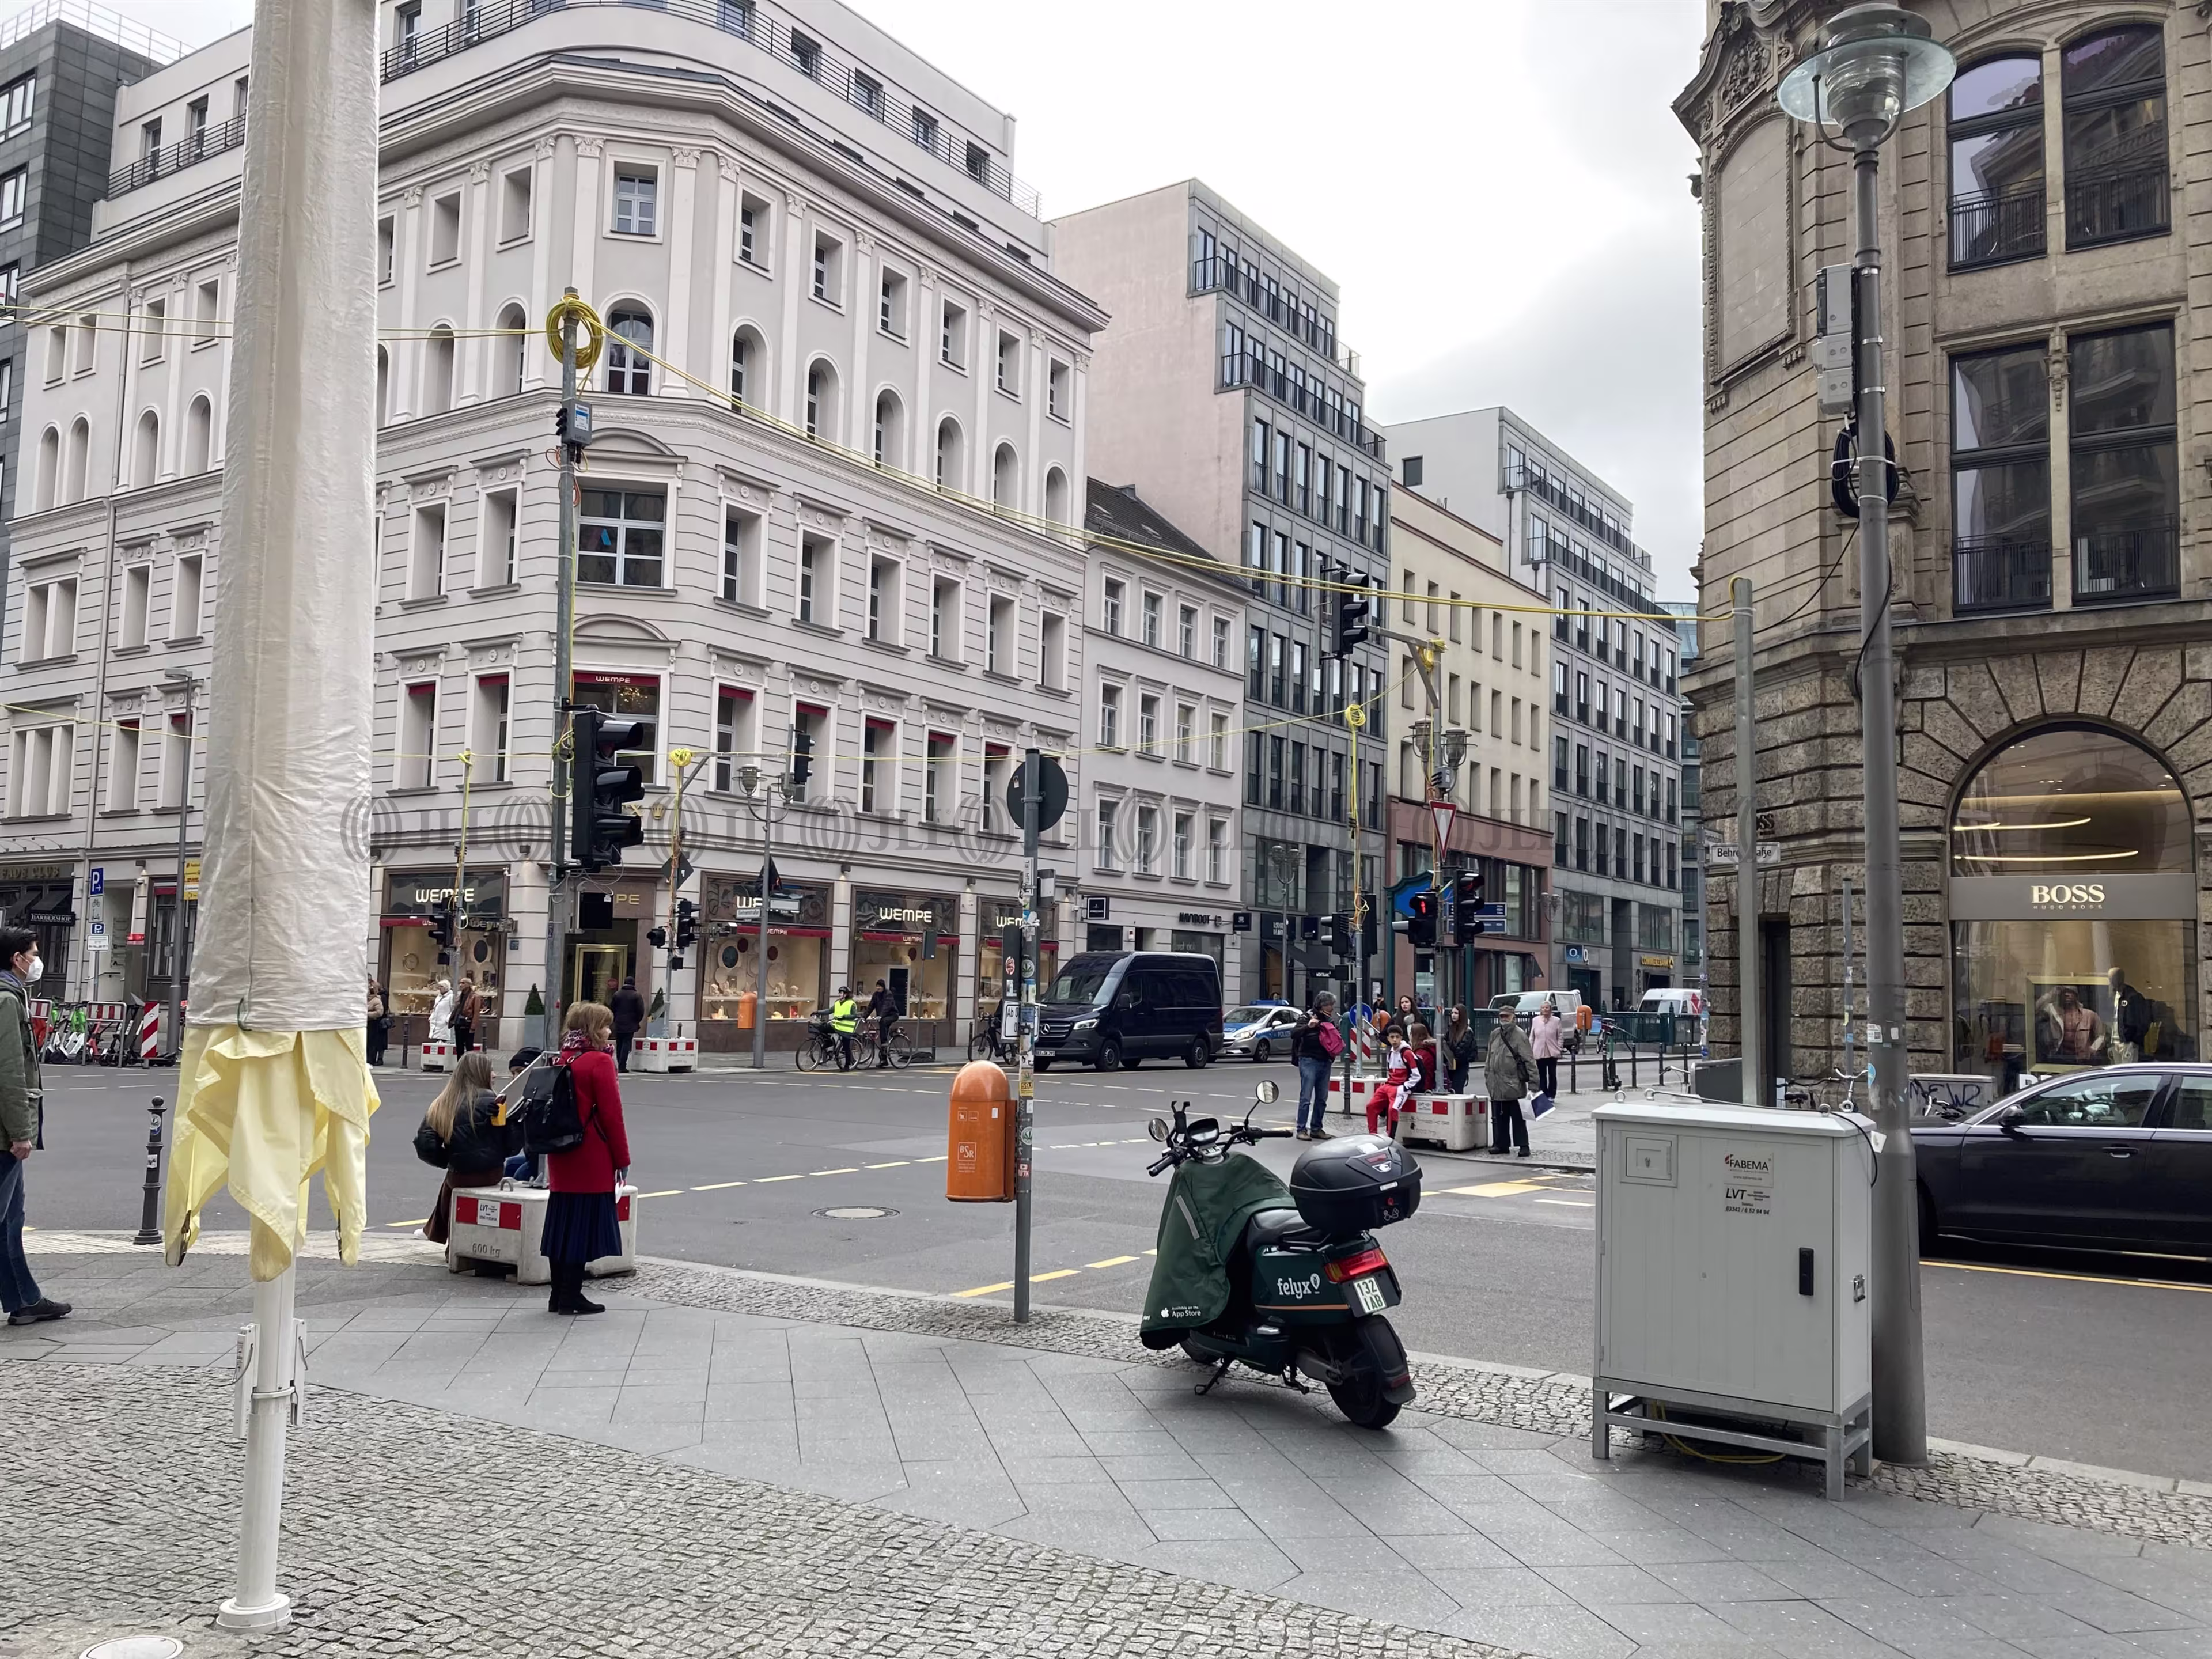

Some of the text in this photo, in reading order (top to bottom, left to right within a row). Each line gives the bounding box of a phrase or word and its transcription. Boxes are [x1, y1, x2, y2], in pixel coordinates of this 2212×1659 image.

[596, 676, 631, 684] WEMPE
[2031, 884, 2105, 903] BOSS
[31, 913, 71, 922] BARBERSHOP
[880, 907, 932, 923] WEMPE
[960, 1145, 974, 1158] BSR
[1730, 1159, 1769, 1171] FABEMA
[1726, 1188, 1747, 1200] LVT
[1277, 1277, 1312, 1299] felyx
[1357, 1279, 1377, 1296] 132
